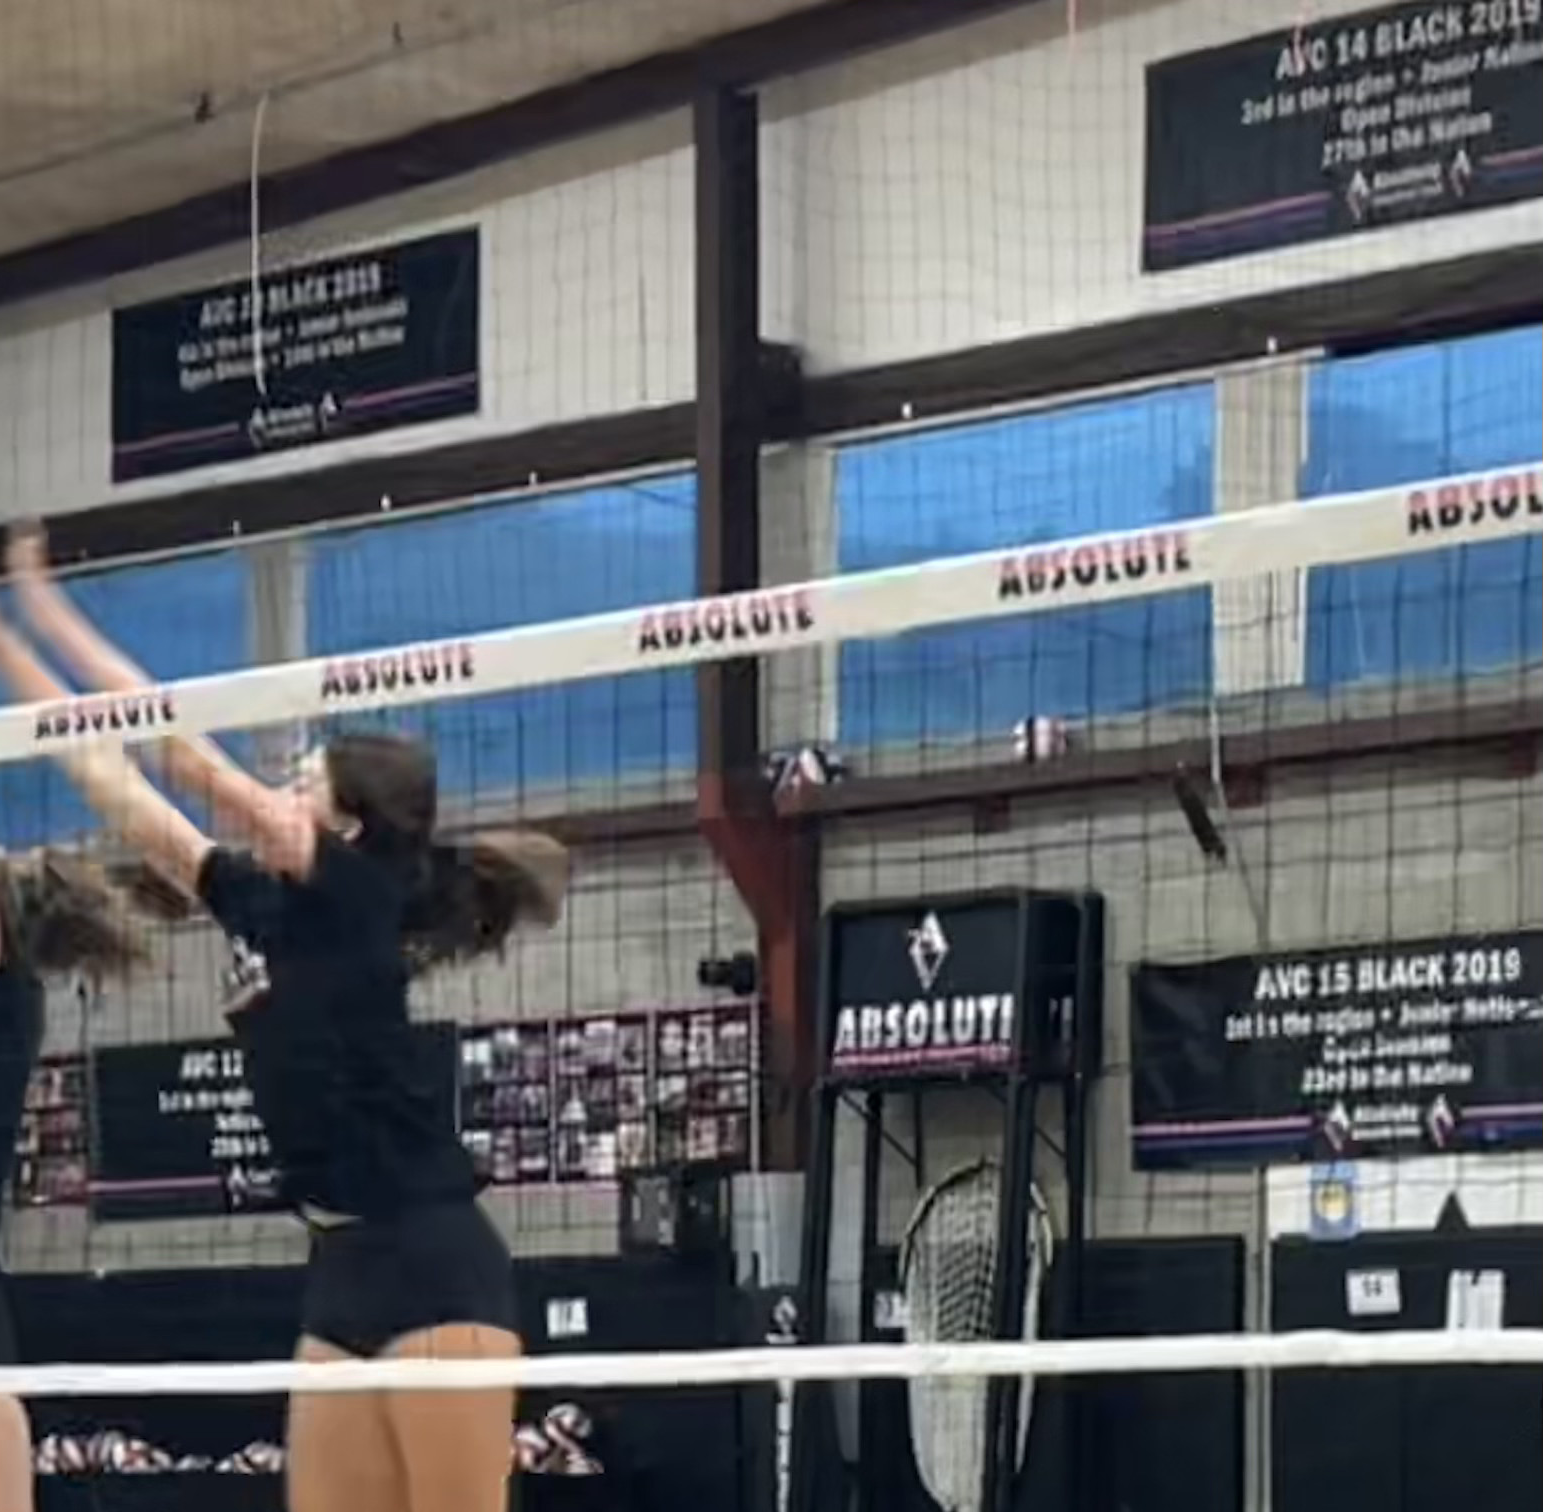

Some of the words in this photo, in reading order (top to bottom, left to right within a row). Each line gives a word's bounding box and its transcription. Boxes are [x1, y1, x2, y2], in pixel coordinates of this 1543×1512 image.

[1336, 29, 1368, 66] 14
[1374, 6, 1464, 54] BLACK
[998, 530, 1193, 599] ABSOLUTE
[639, 591, 816, 654] ABSOLUTE
[320, 642, 475, 699] ABSOLUTE
[1254, 962, 1310, 1000] AVC
[1318, 961, 1351, 995] 15
[1357, 953, 1445, 993] BLACK
[1451, 946, 1521, 985] 2019
